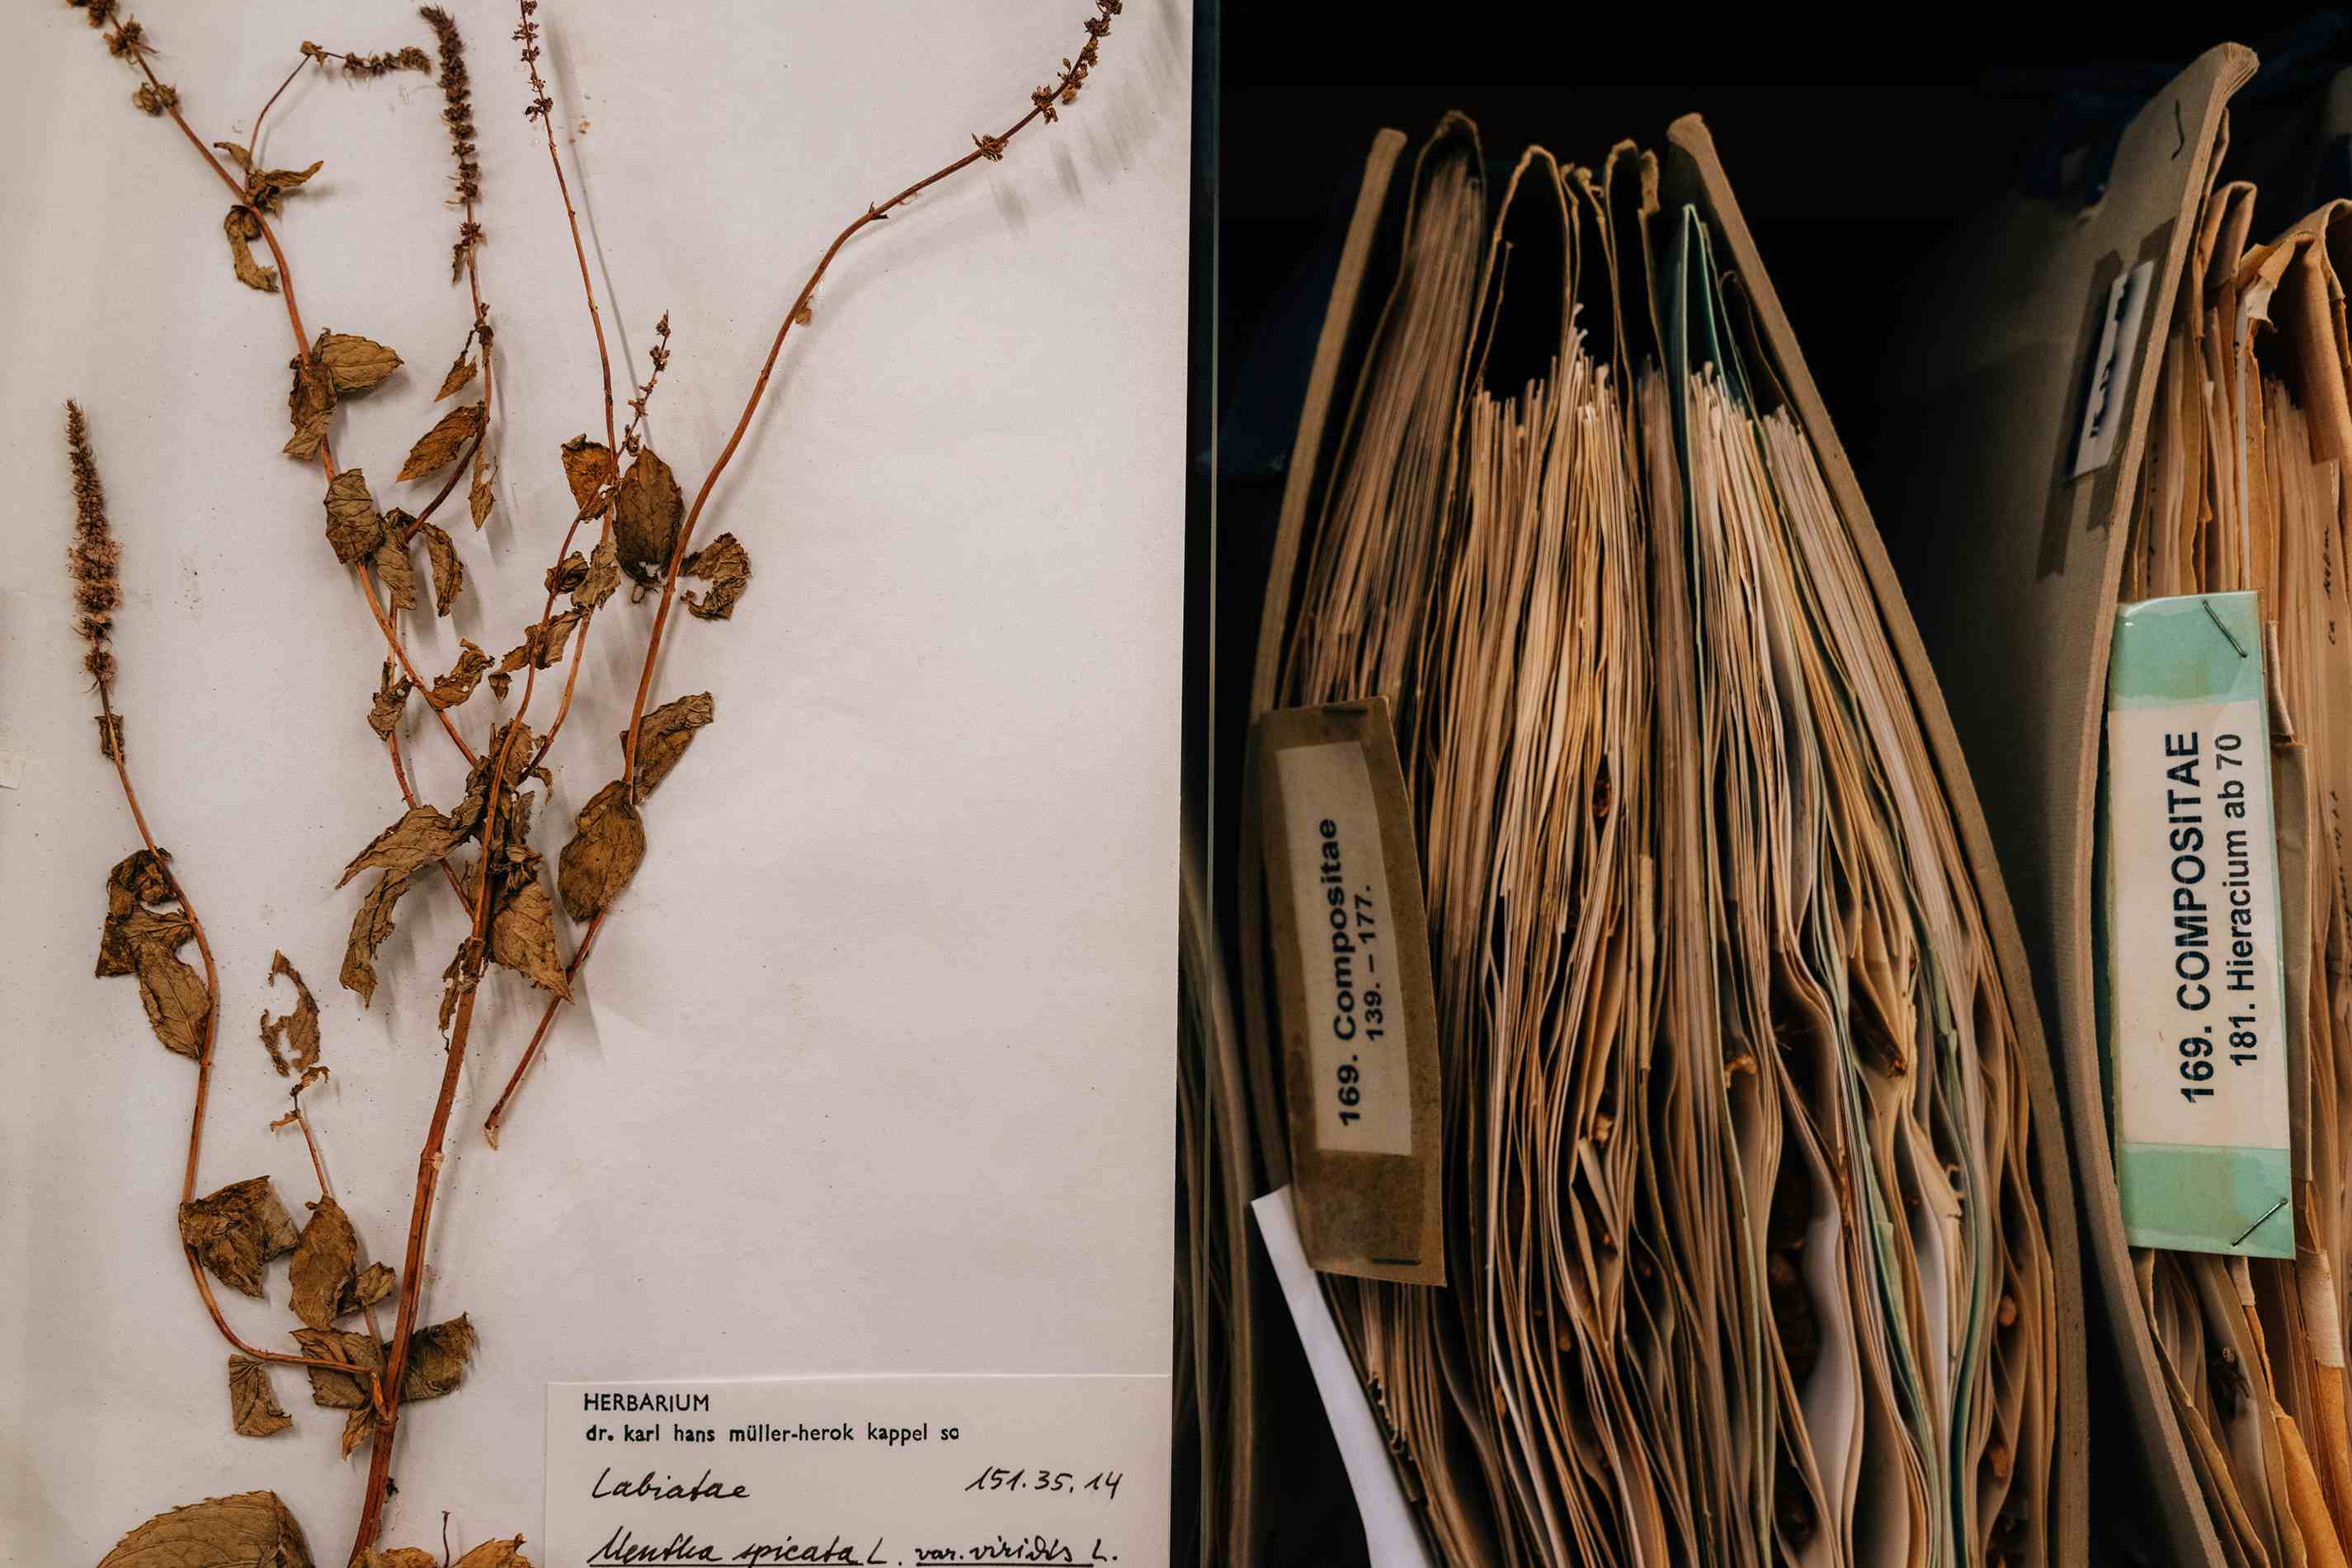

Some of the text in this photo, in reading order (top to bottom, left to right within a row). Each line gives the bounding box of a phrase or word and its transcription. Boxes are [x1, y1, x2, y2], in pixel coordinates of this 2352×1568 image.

[2165, 732, 2214, 1103] 169. COMPOSITAE
[2214, 733, 2258, 1067] 181. Hieracium ab 70
[1320, 818, 1361, 1127] 169. Compositae
[584, 1392, 709, 1413] HERBARIUM
[586, 1424, 614, 1442] dr.
[624, 1424, 660, 1442] karl
[674, 1423, 715, 1443] hans
[729, 1422, 854, 1443] müller-herok
[867, 1422, 927, 1447] kappel
[592, 1467, 750, 1502] Labiatae
[587, 1525, 723, 1564] Mentha
[733, 1535, 861, 1567] spicata
[915, 1547, 964, 1561] var.
[969, 1535, 1073, 1563] viridis
[1091, 1538, 1118, 1561] L.
